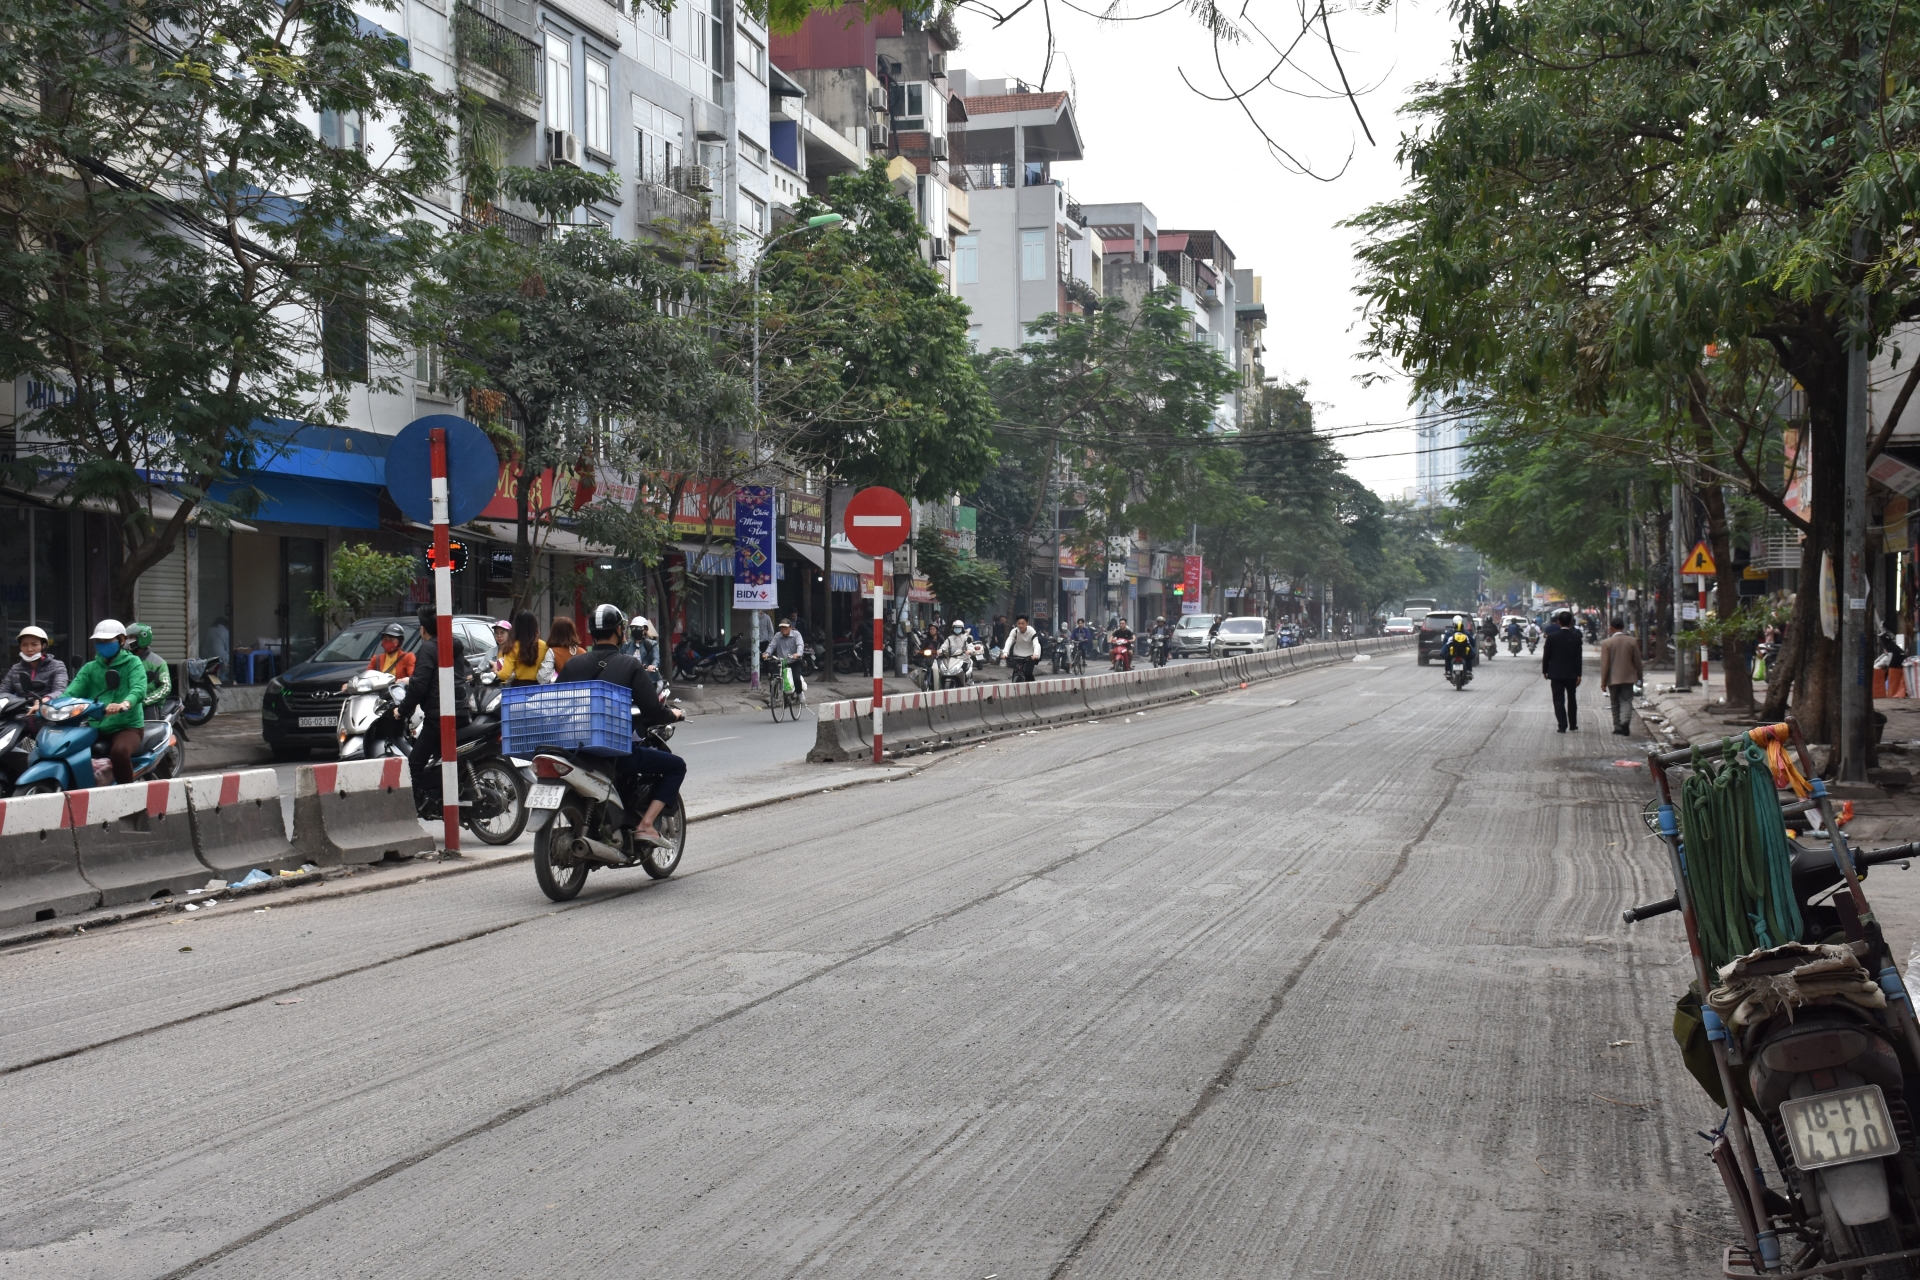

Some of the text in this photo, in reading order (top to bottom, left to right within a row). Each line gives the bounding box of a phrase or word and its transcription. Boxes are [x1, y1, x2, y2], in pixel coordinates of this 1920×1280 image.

[736, 590, 759, 599] BIDV
[300, 717, 338, 727] 30G-021.93
[527, 796, 559, 808] 054.93
[1791, 1025, 1824, 1034] HONDA
[1800, 1094, 1871, 1132] 18-F1
